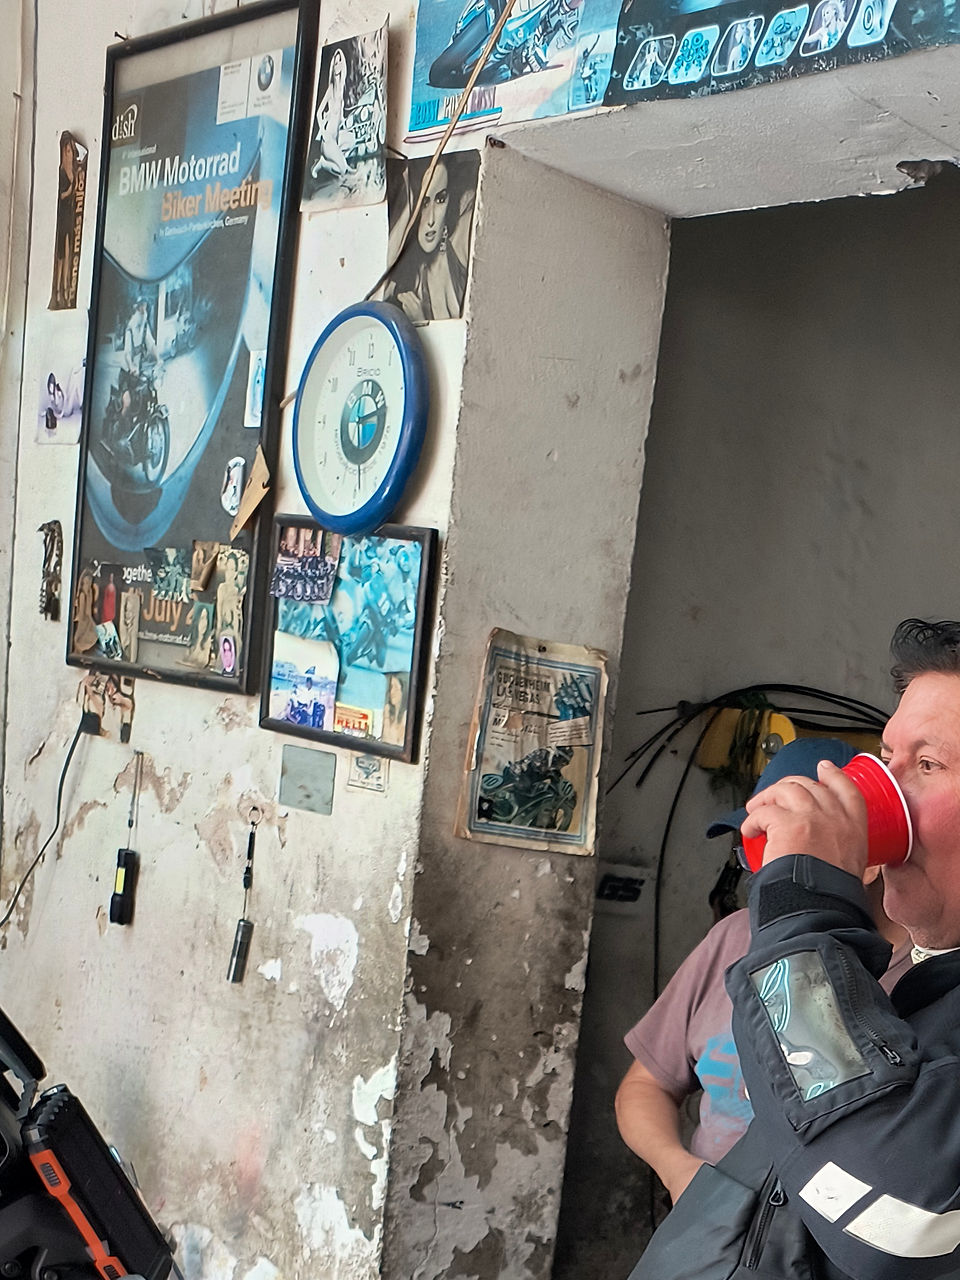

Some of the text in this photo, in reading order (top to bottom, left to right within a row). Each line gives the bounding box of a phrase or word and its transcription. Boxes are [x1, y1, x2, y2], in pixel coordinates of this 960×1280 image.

[112, 104, 138, 141] dish
[119, 142, 241, 196] BMW Motorrad
[161, 174, 274, 222] Biker Meeting
[73, 215, 82, 251] más
[346, 380, 387, 409] BMW
[143, 588, 183, 632] July
[597, 873, 646, 902] GS
